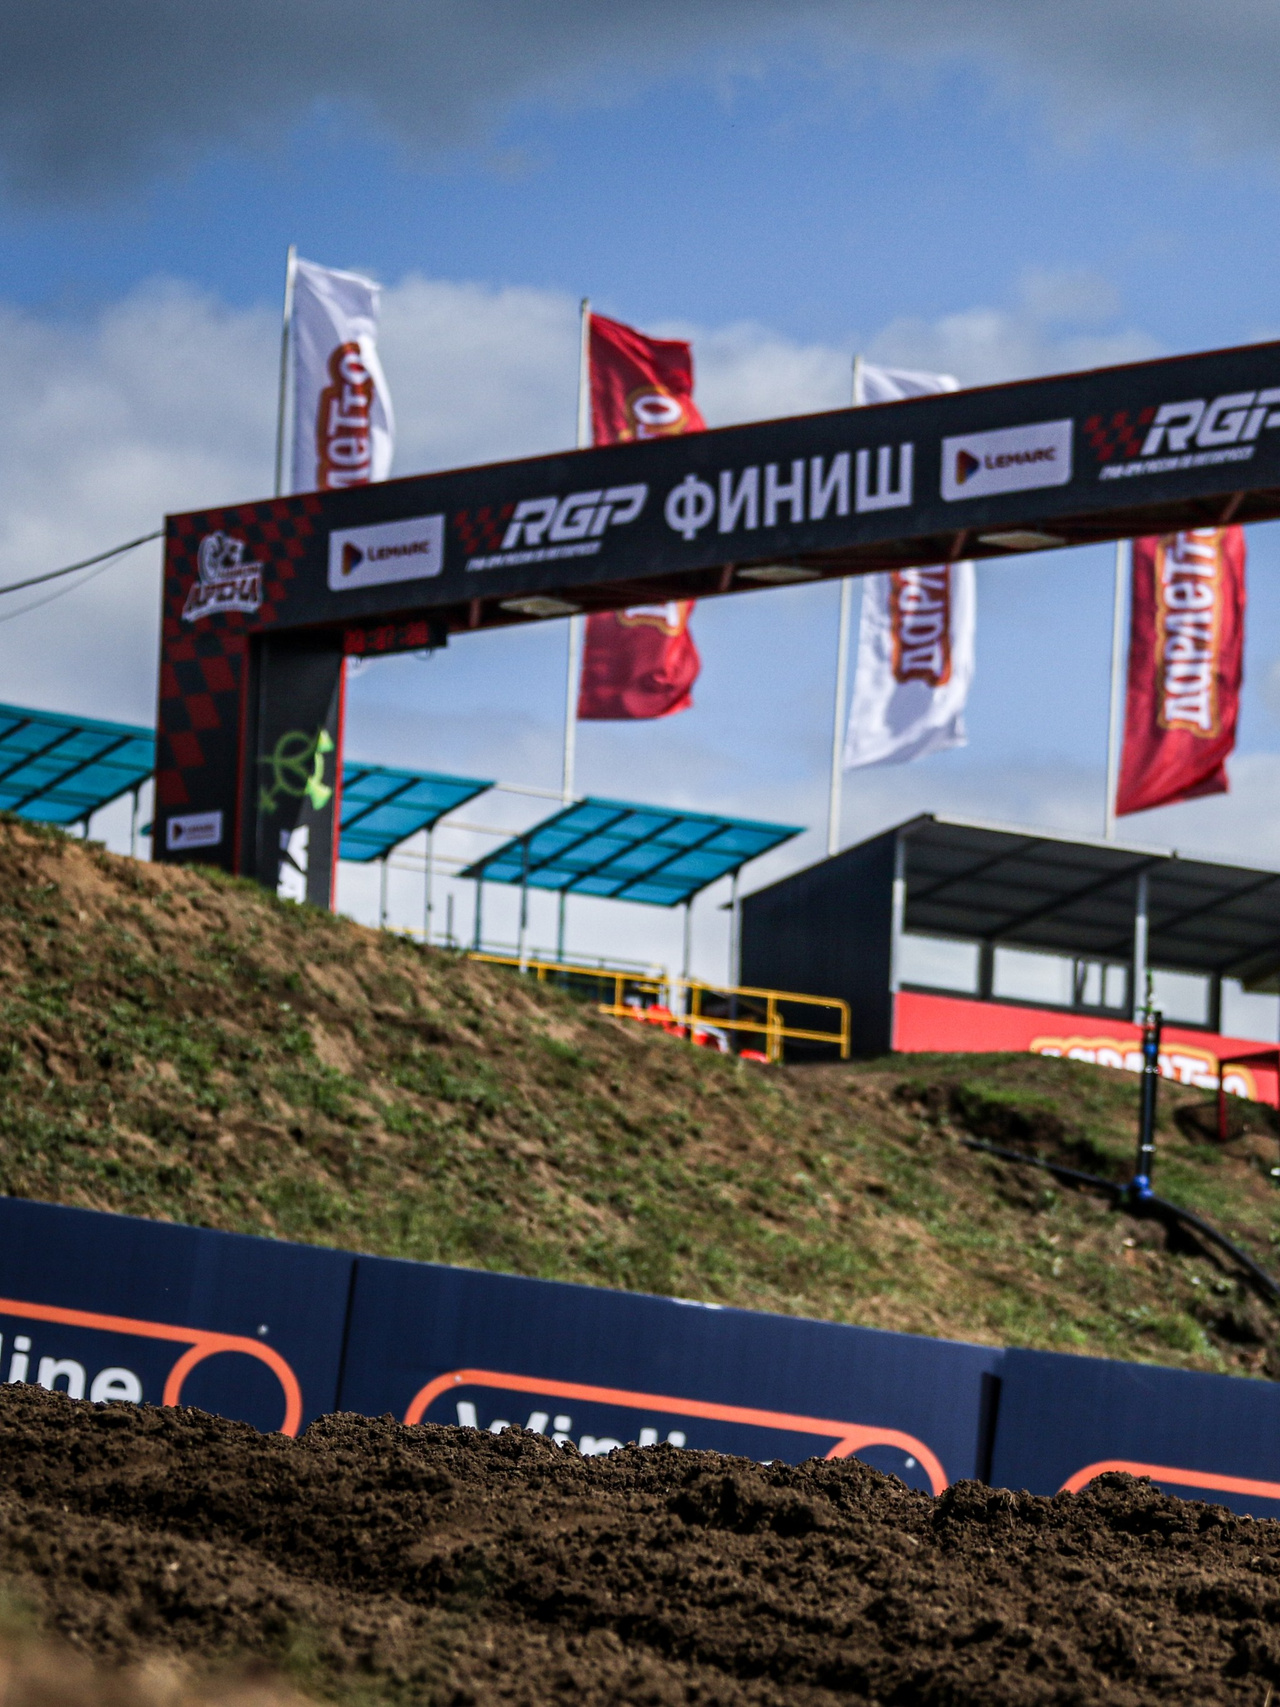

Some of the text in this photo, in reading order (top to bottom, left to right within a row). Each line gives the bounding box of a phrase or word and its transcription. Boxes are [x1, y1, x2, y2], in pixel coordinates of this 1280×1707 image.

[664, 442, 914, 541] ФИНИШ
[984, 446, 1057, 470] LEMARC
[500, 483, 649, 550] RGP
[367, 540, 431, 564] LEMARC
[0, 1334, 143, 1406] ine
